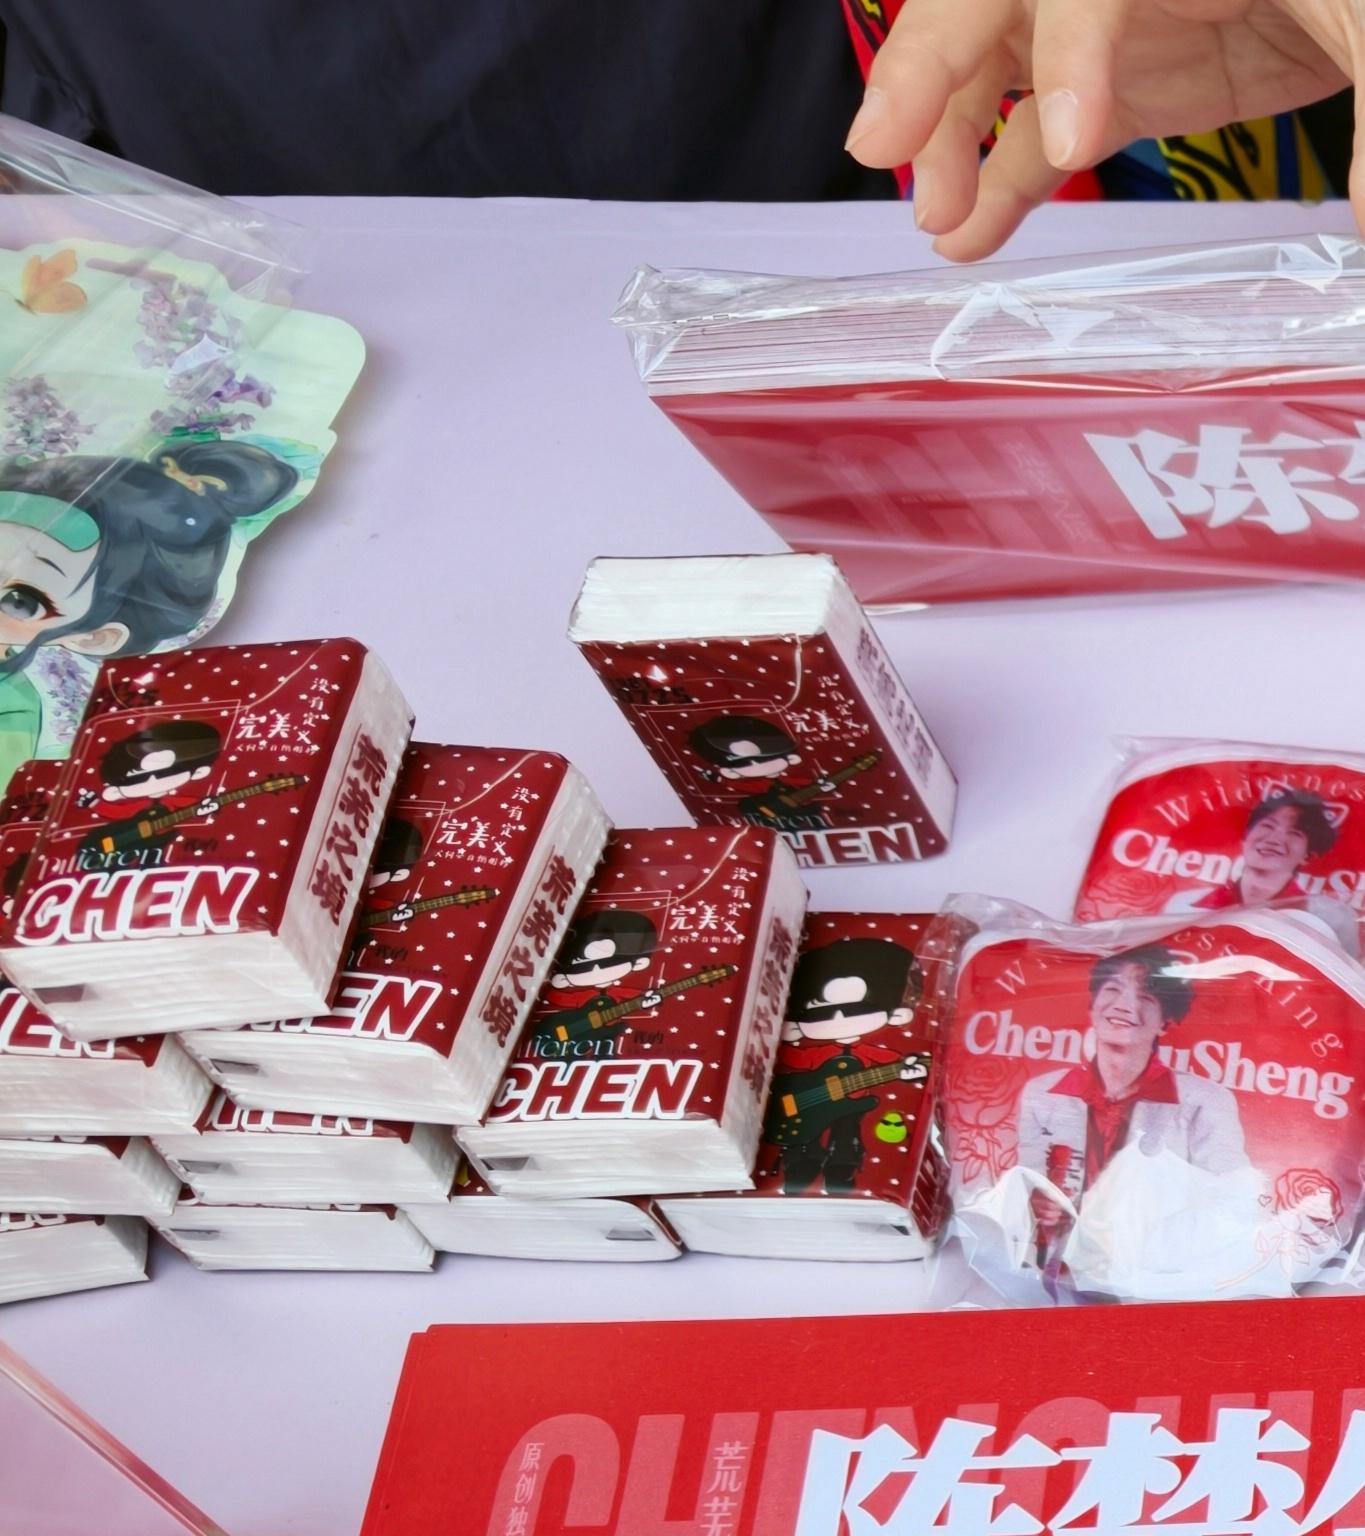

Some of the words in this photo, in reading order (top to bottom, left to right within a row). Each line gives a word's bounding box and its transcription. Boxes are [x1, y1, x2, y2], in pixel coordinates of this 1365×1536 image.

[783, 822, 924, 868] HEN
[14, 866, 260, 946] CHEN
[490, 1059, 703, 1121] CHEN
